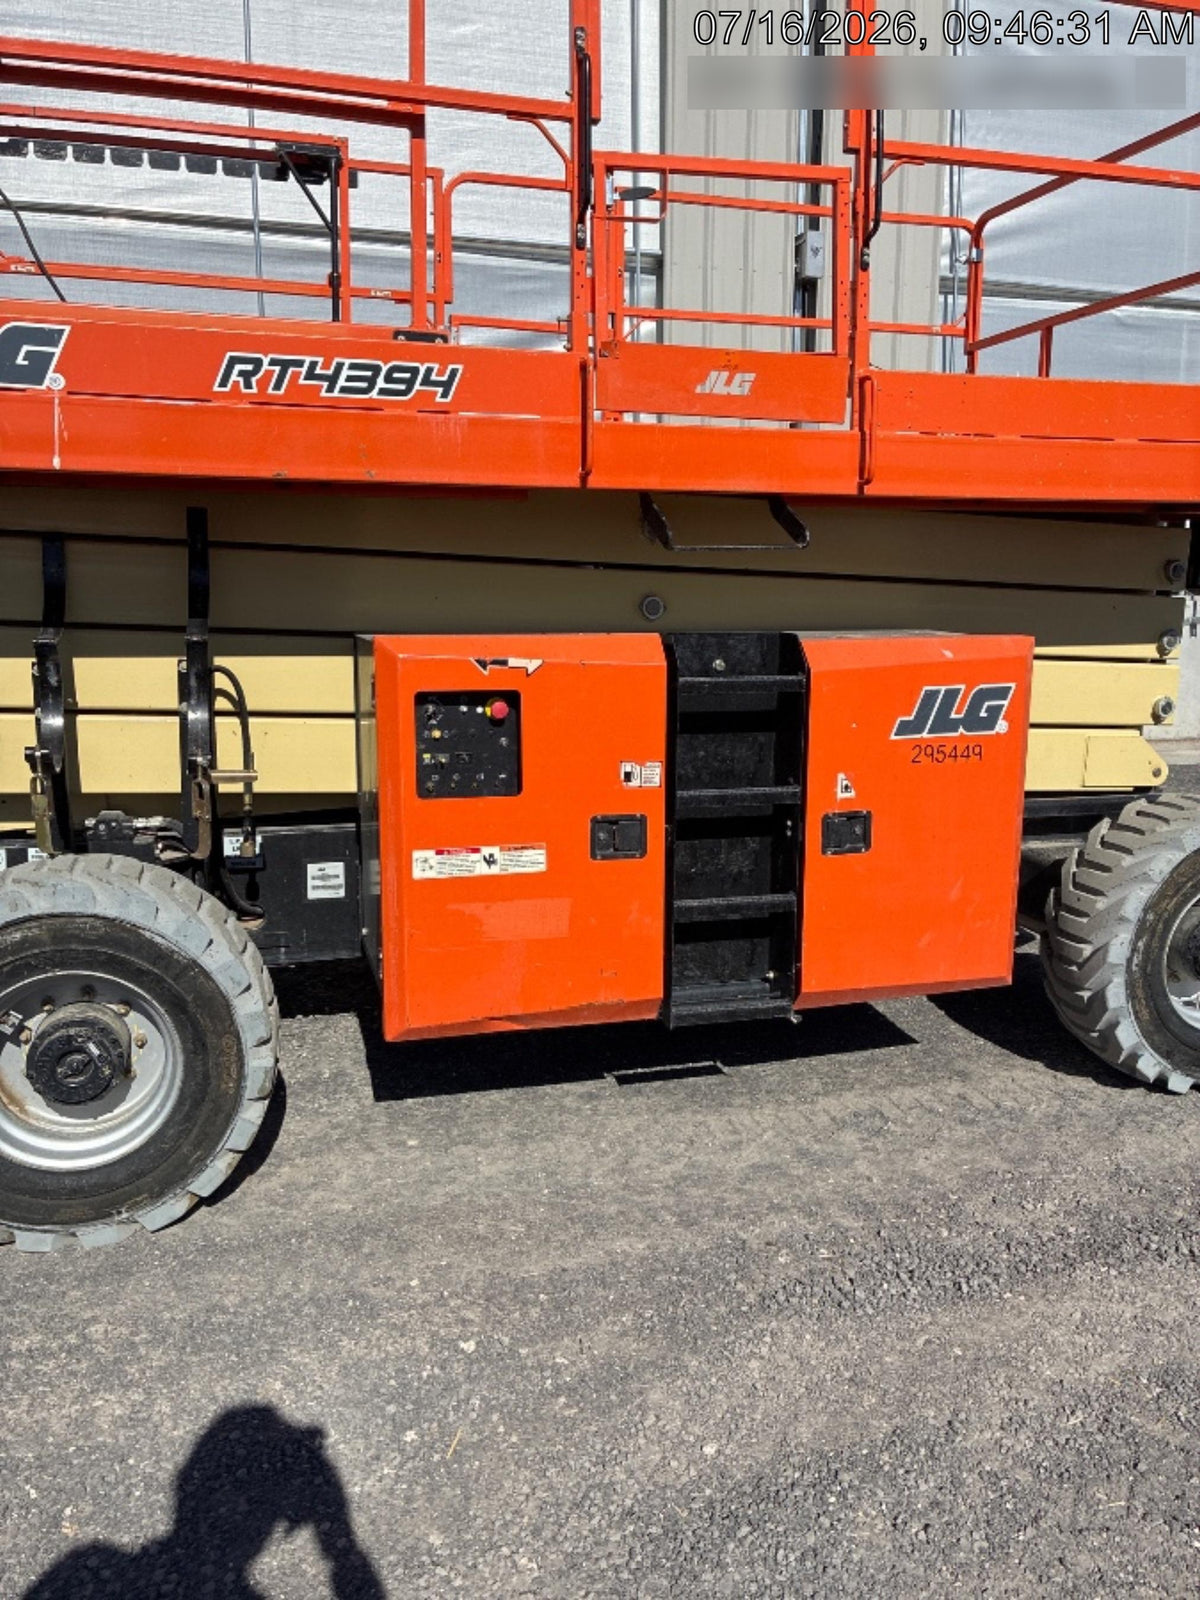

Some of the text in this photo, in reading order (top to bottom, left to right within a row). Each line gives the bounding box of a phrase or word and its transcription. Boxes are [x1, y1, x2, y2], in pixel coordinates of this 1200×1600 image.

[212, 351, 463, 402] RT4394
[694, 370, 756, 396] JLG
[889, 683, 1017, 740] JLG
[911, 744, 983, 764] 295449
